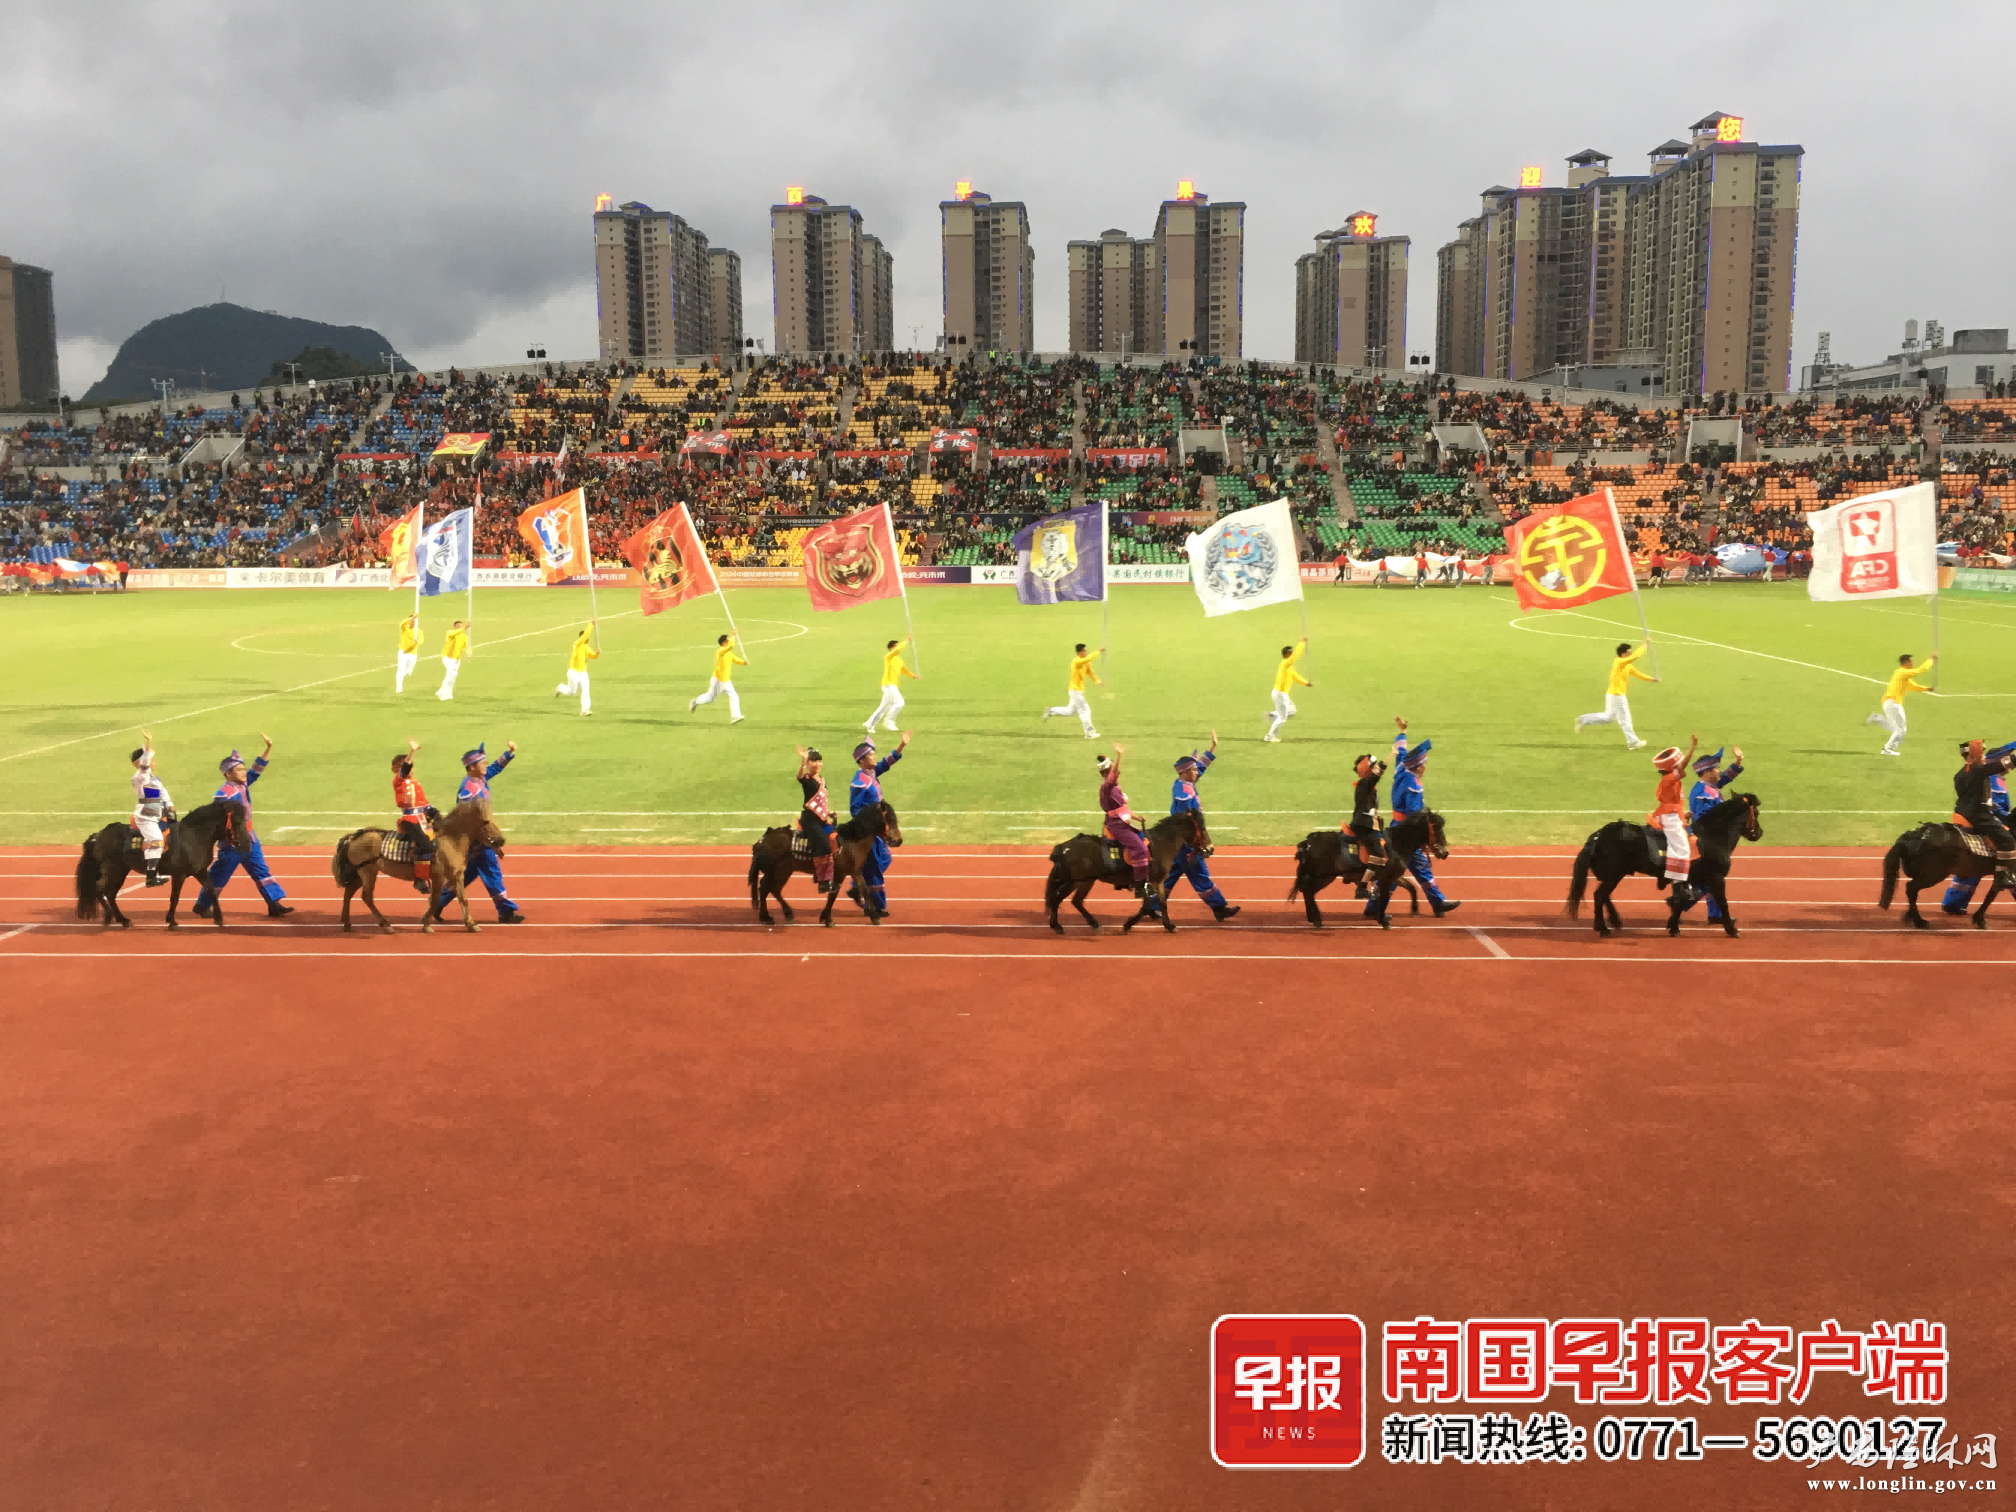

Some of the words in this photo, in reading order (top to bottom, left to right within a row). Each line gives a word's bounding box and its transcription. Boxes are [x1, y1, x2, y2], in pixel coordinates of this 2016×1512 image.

[1354, 214, 1375, 236] 欢
[1521, 166, 1541, 188] 迎
[1717, 117, 1742, 142] 您
[256, 571, 325, 584] 卡尔美体育
